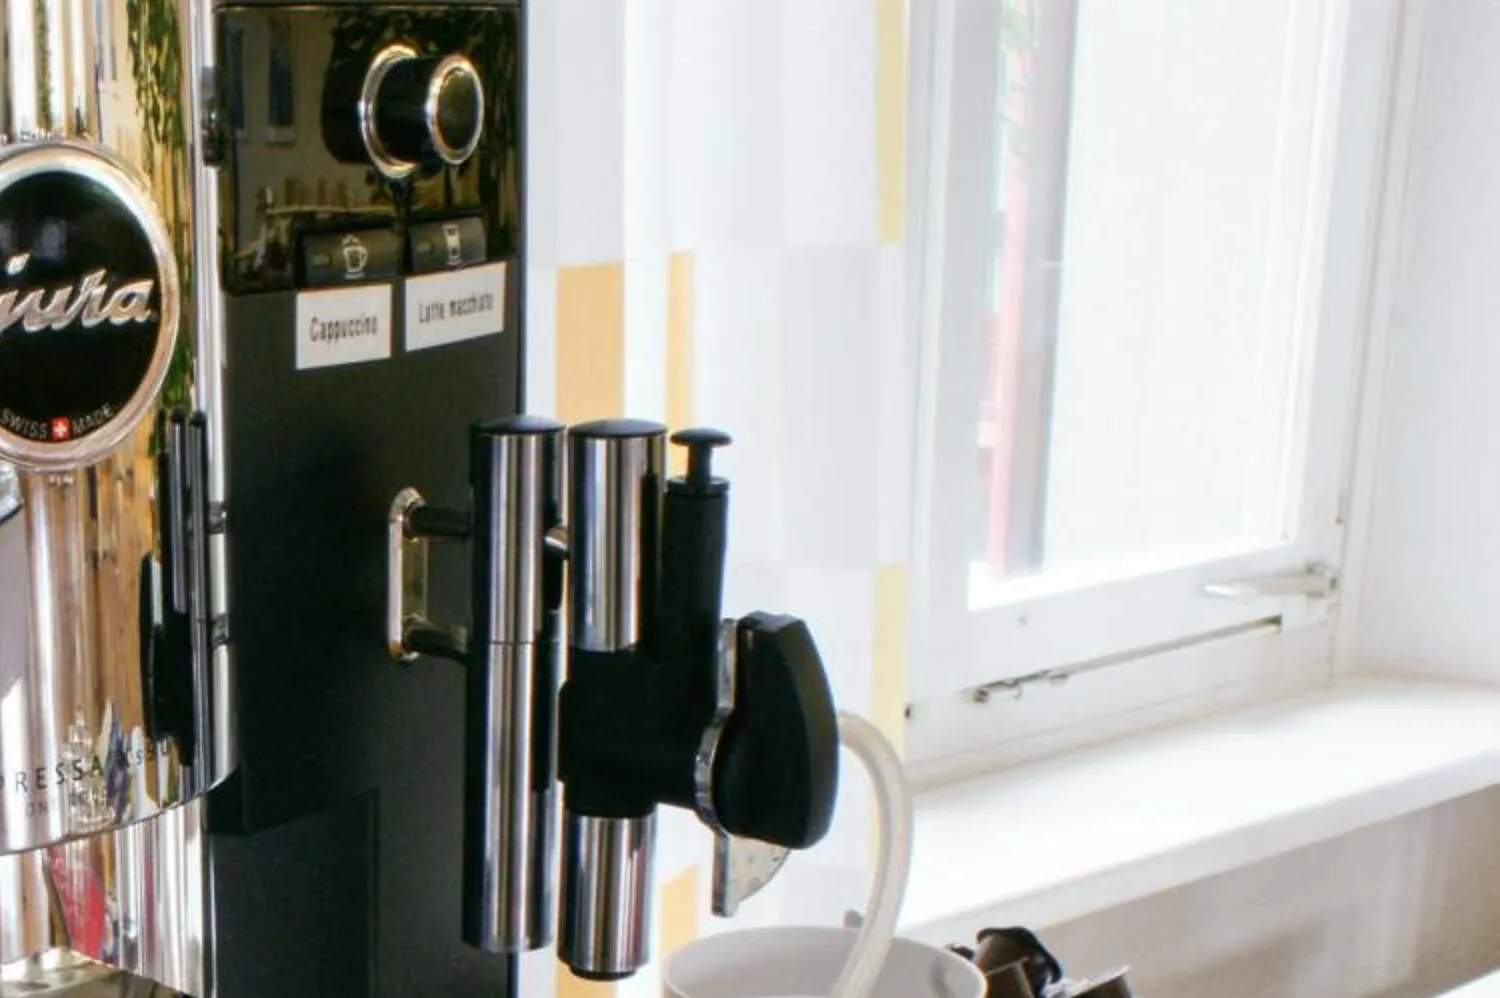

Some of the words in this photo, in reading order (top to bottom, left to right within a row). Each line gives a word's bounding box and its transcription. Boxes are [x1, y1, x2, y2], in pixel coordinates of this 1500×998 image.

[418, 299, 446, 325] Latte
[449, 291, 495, 318] macchiato
[309, 312, 379, 345] Cappuccino
[0, 407, 49, 440] SWISS
[71, 402, 115, 434] MADE
